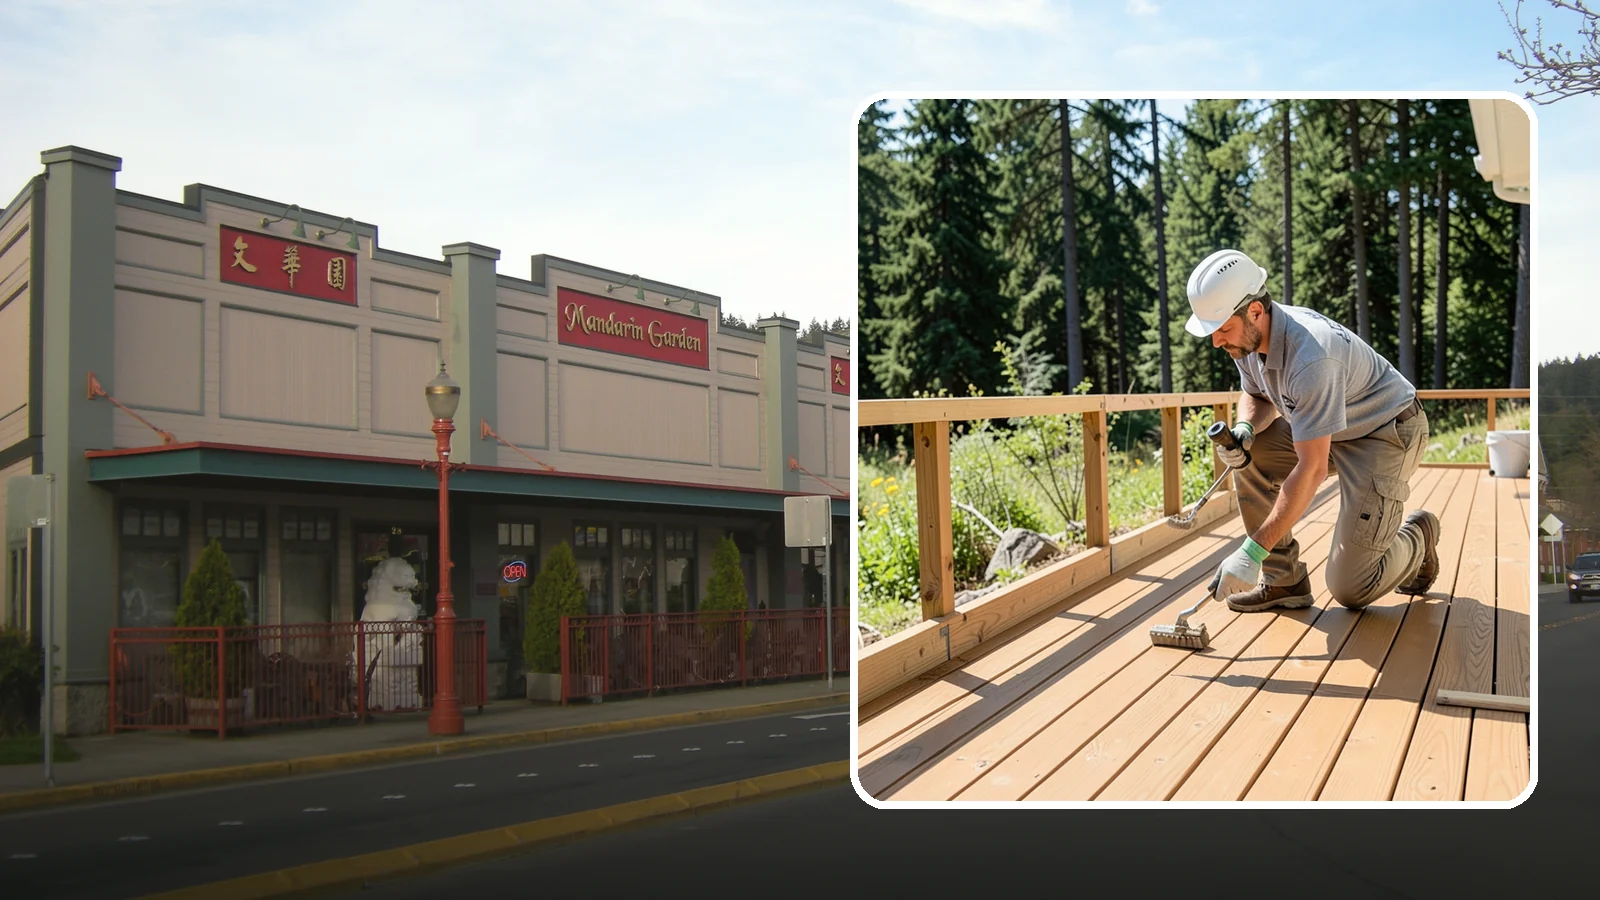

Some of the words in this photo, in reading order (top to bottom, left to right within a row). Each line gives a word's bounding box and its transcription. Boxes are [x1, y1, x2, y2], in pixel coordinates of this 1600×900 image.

[231, 235, 346, 291] 文華園
[564, 302, 644, 341] Mandarin
[647, 320, 702, 352] Garden
[503, 565, 527, 578] OPEN
